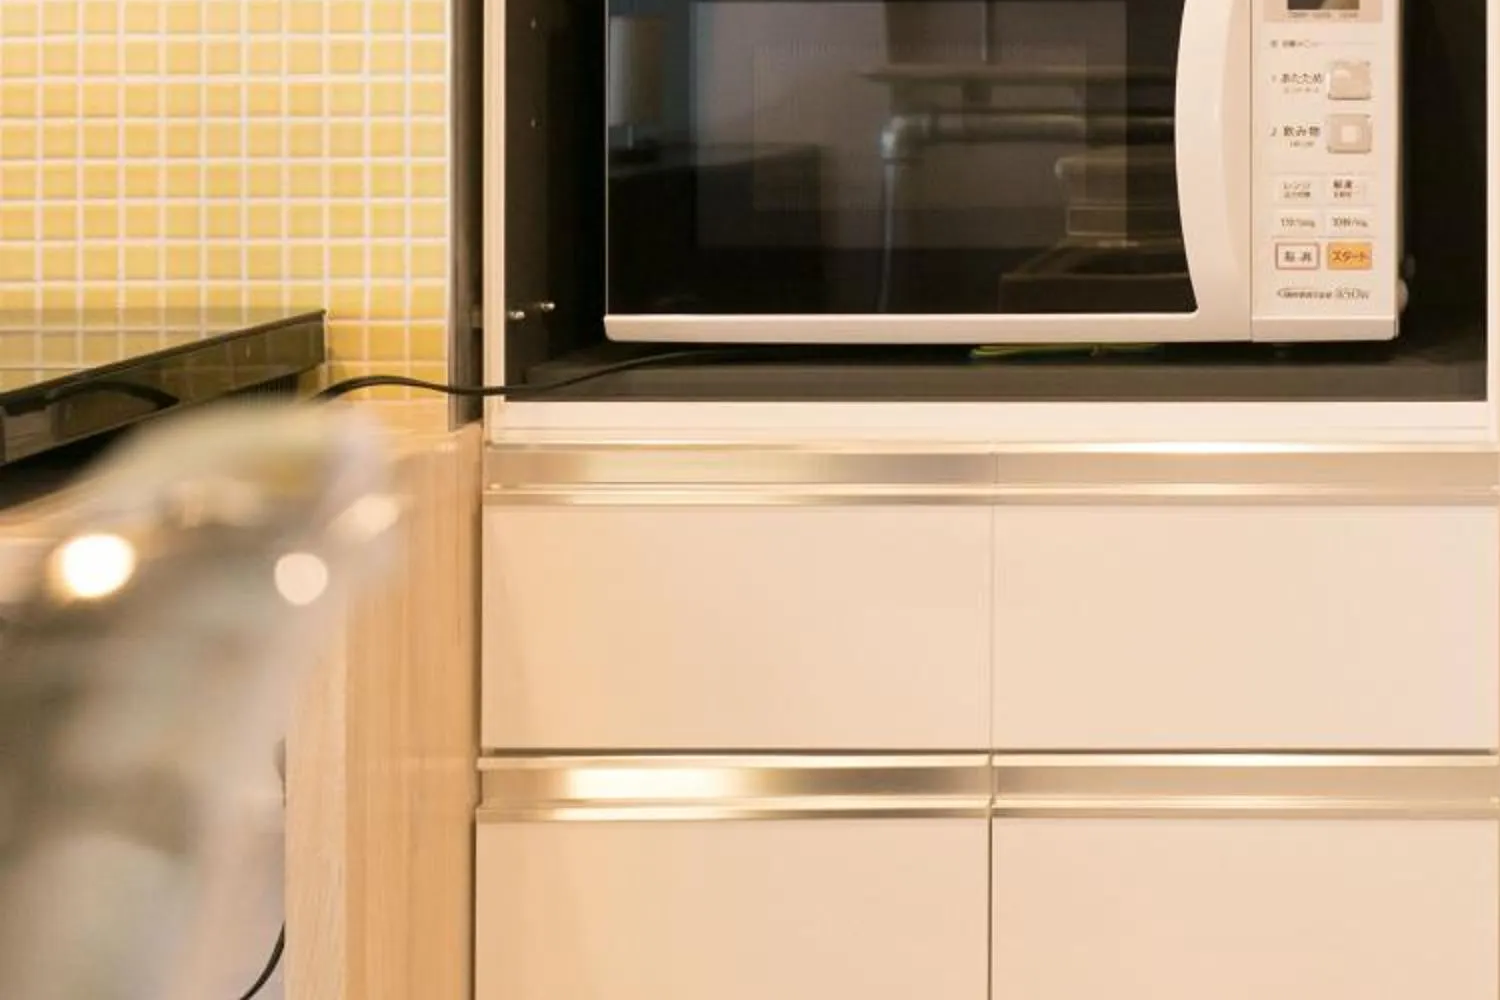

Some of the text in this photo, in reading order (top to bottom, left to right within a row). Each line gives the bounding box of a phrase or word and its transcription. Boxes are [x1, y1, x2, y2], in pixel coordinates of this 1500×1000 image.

[1280, 72, 1324, 84] あたため
[1283, 125, 1321, 137] 飲み物
[1331, 250, 1370, 263] スタート
